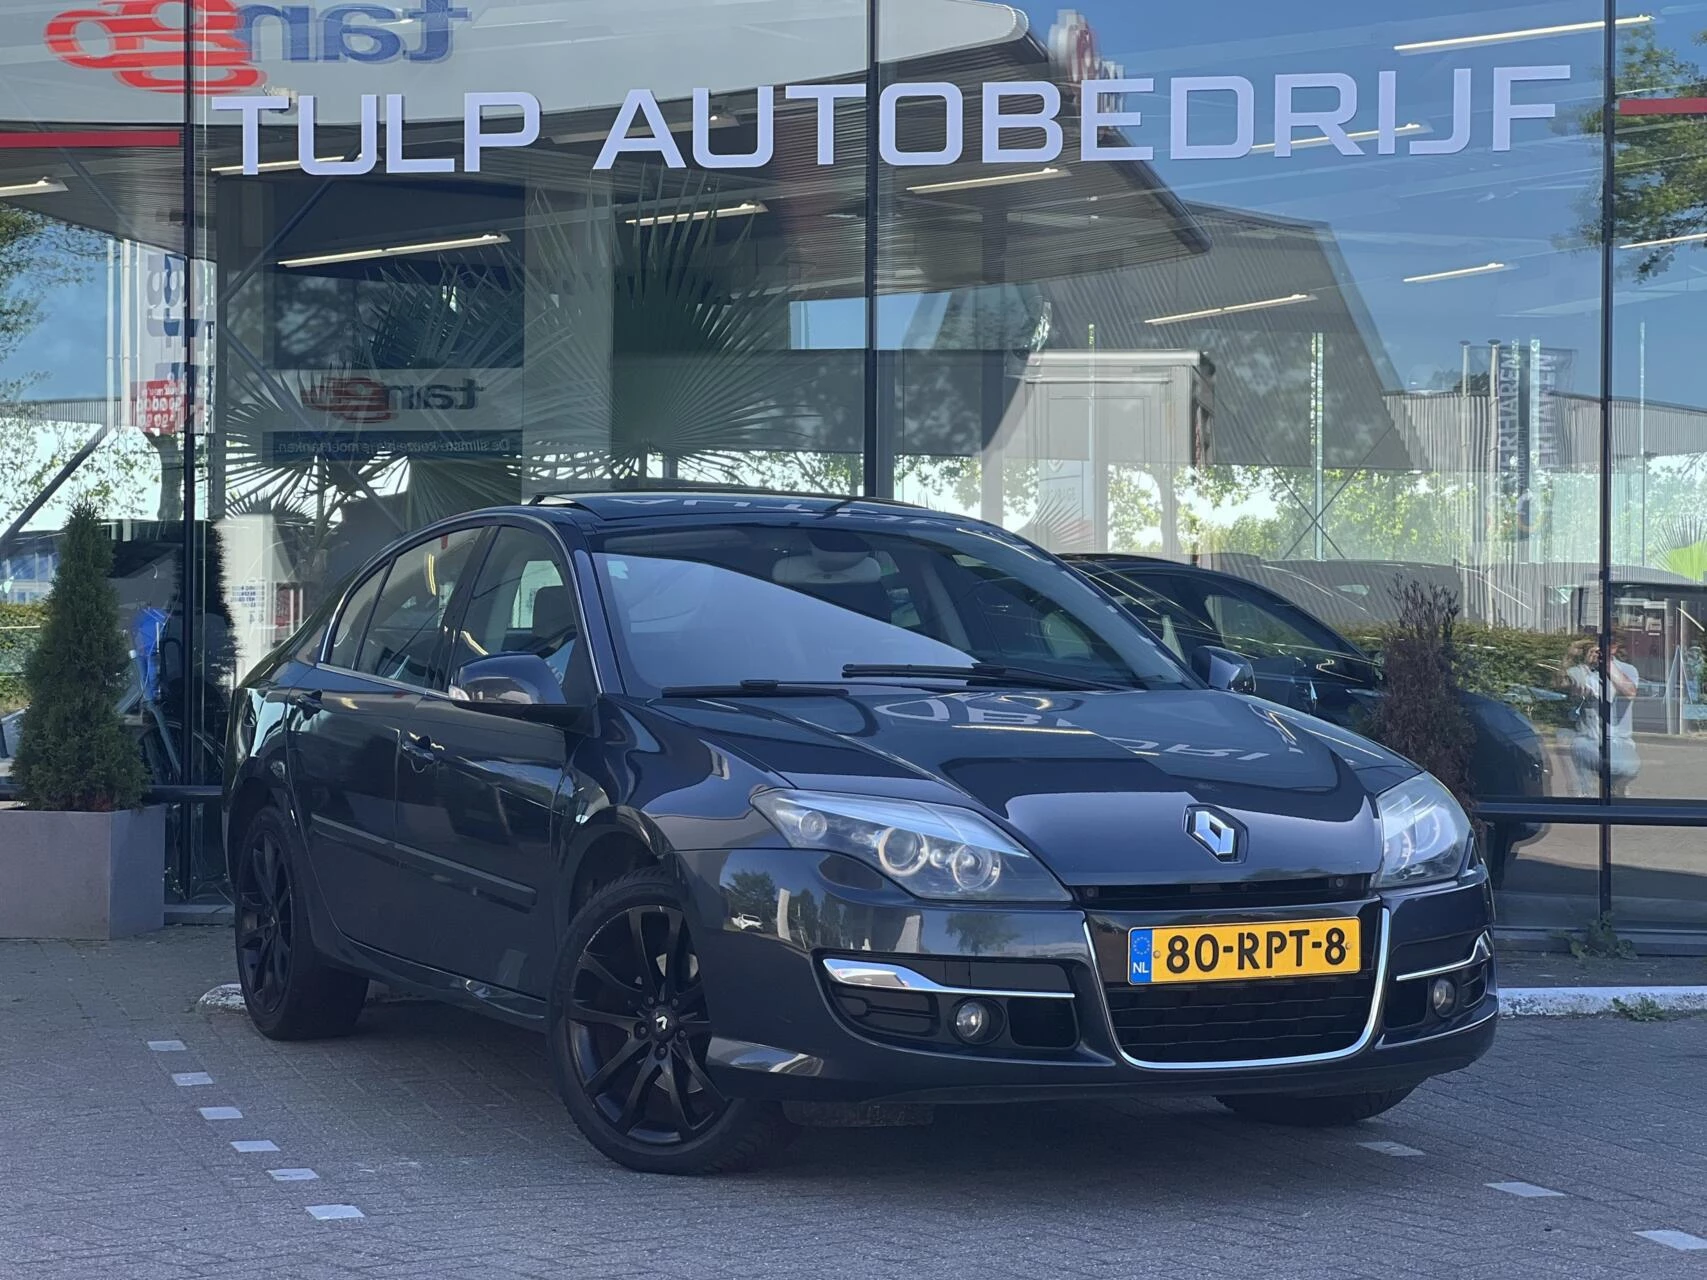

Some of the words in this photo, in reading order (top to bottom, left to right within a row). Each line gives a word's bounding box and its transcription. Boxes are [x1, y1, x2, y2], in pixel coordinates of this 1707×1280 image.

[211, 91, 541, 176] TULP
[592, 64, 1571, 170] AUTOBEDRIJF
[1132, 961, 1149, 974] NL
[1166, 927, 1346, 974] 80-RPT-8
